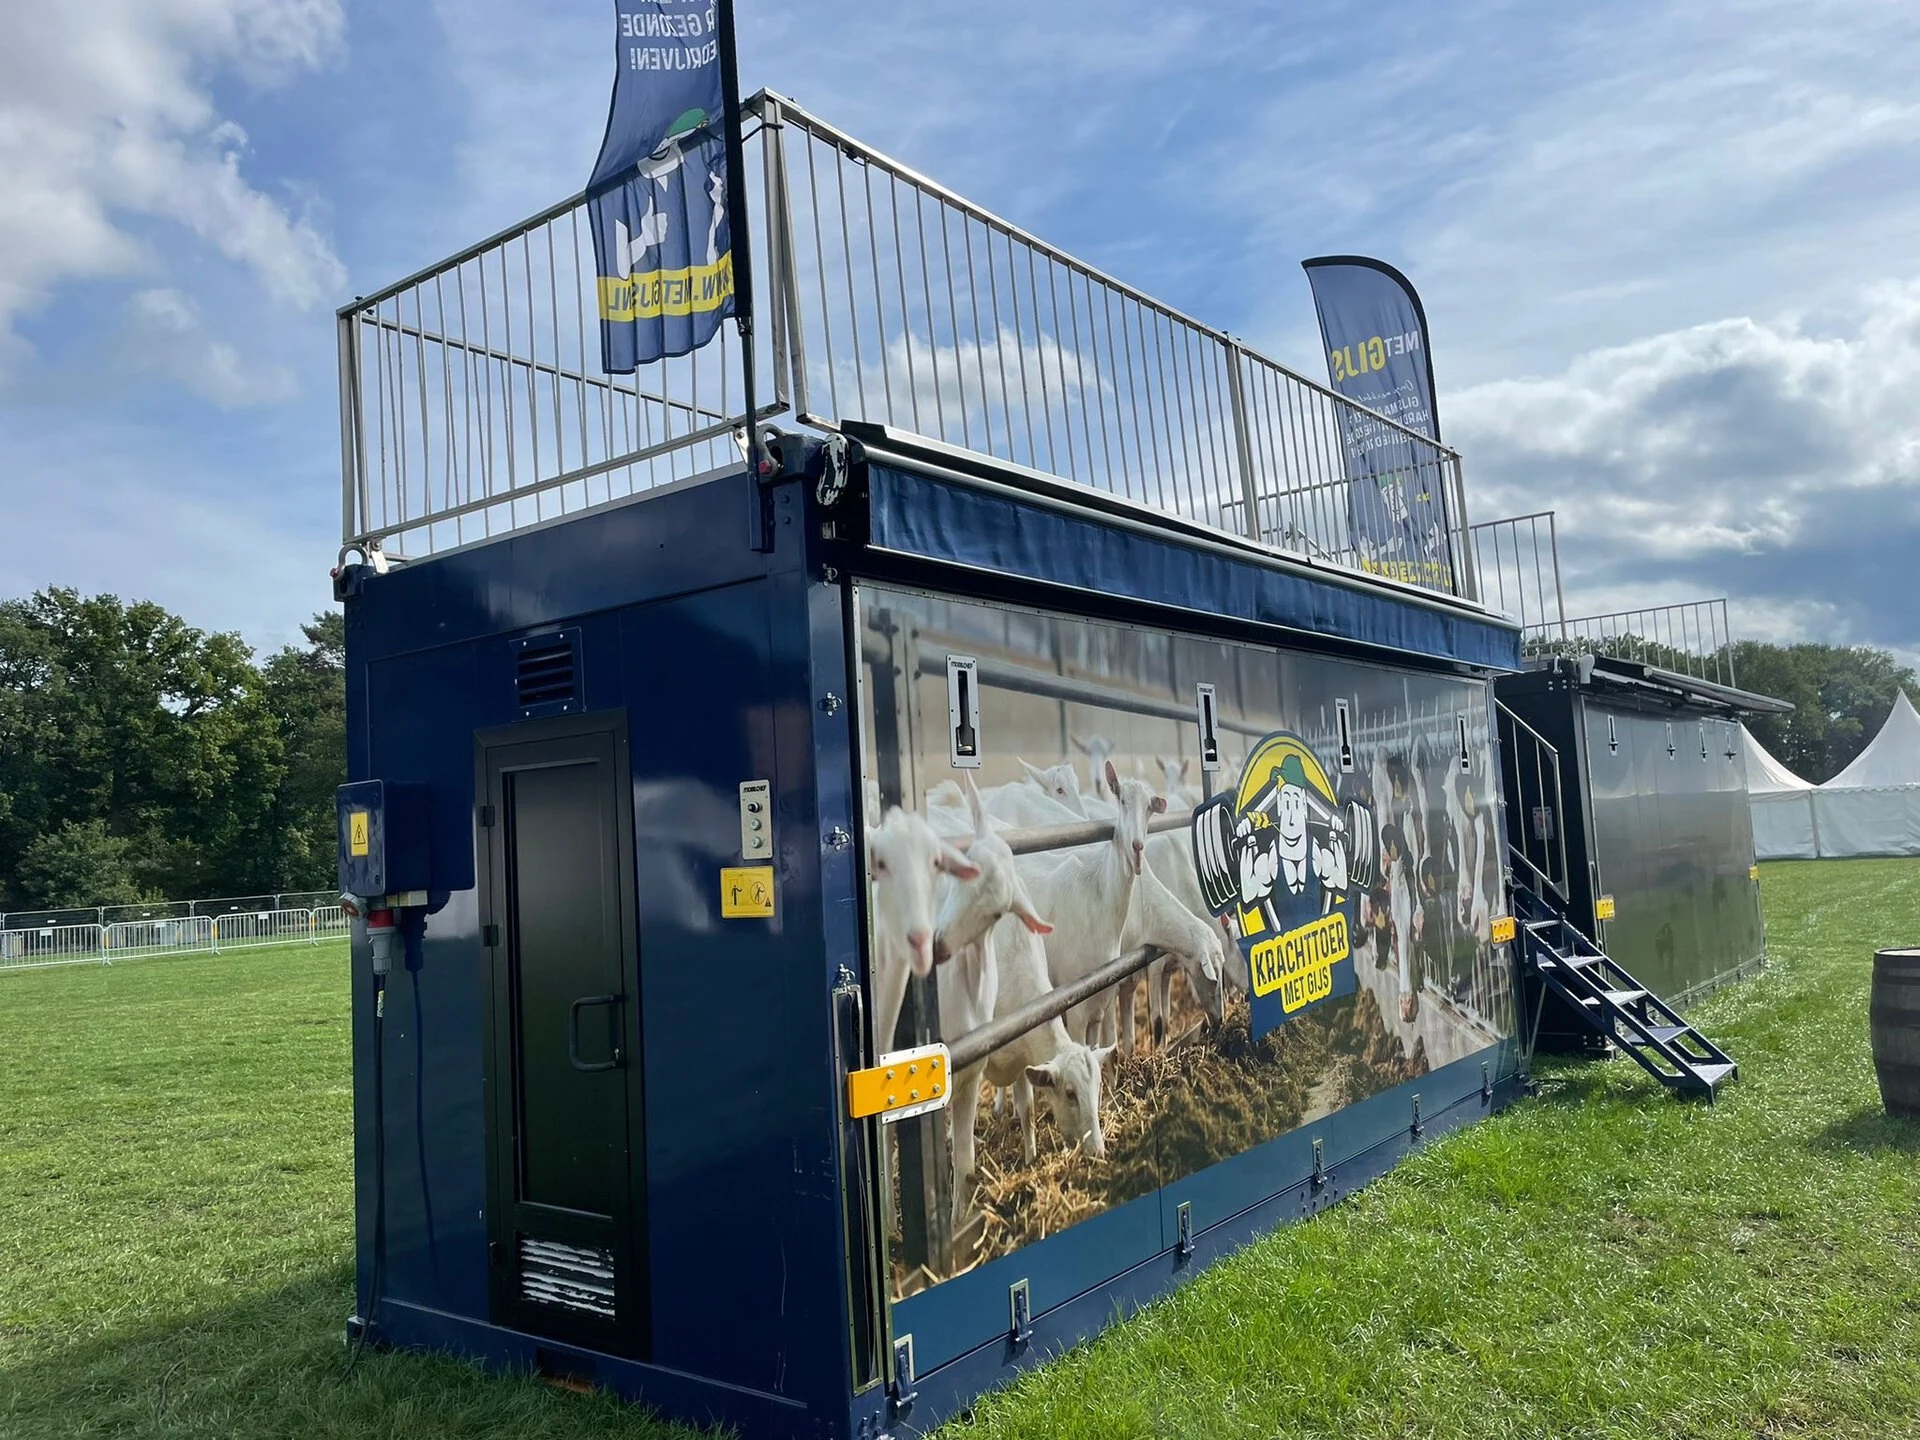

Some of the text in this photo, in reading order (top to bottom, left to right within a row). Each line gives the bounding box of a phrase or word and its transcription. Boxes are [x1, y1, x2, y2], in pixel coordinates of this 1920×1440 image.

[1255, 921, 1345, 987] KRACHTTOER
[1284, 966, 1329, 1006] MET GIJS
